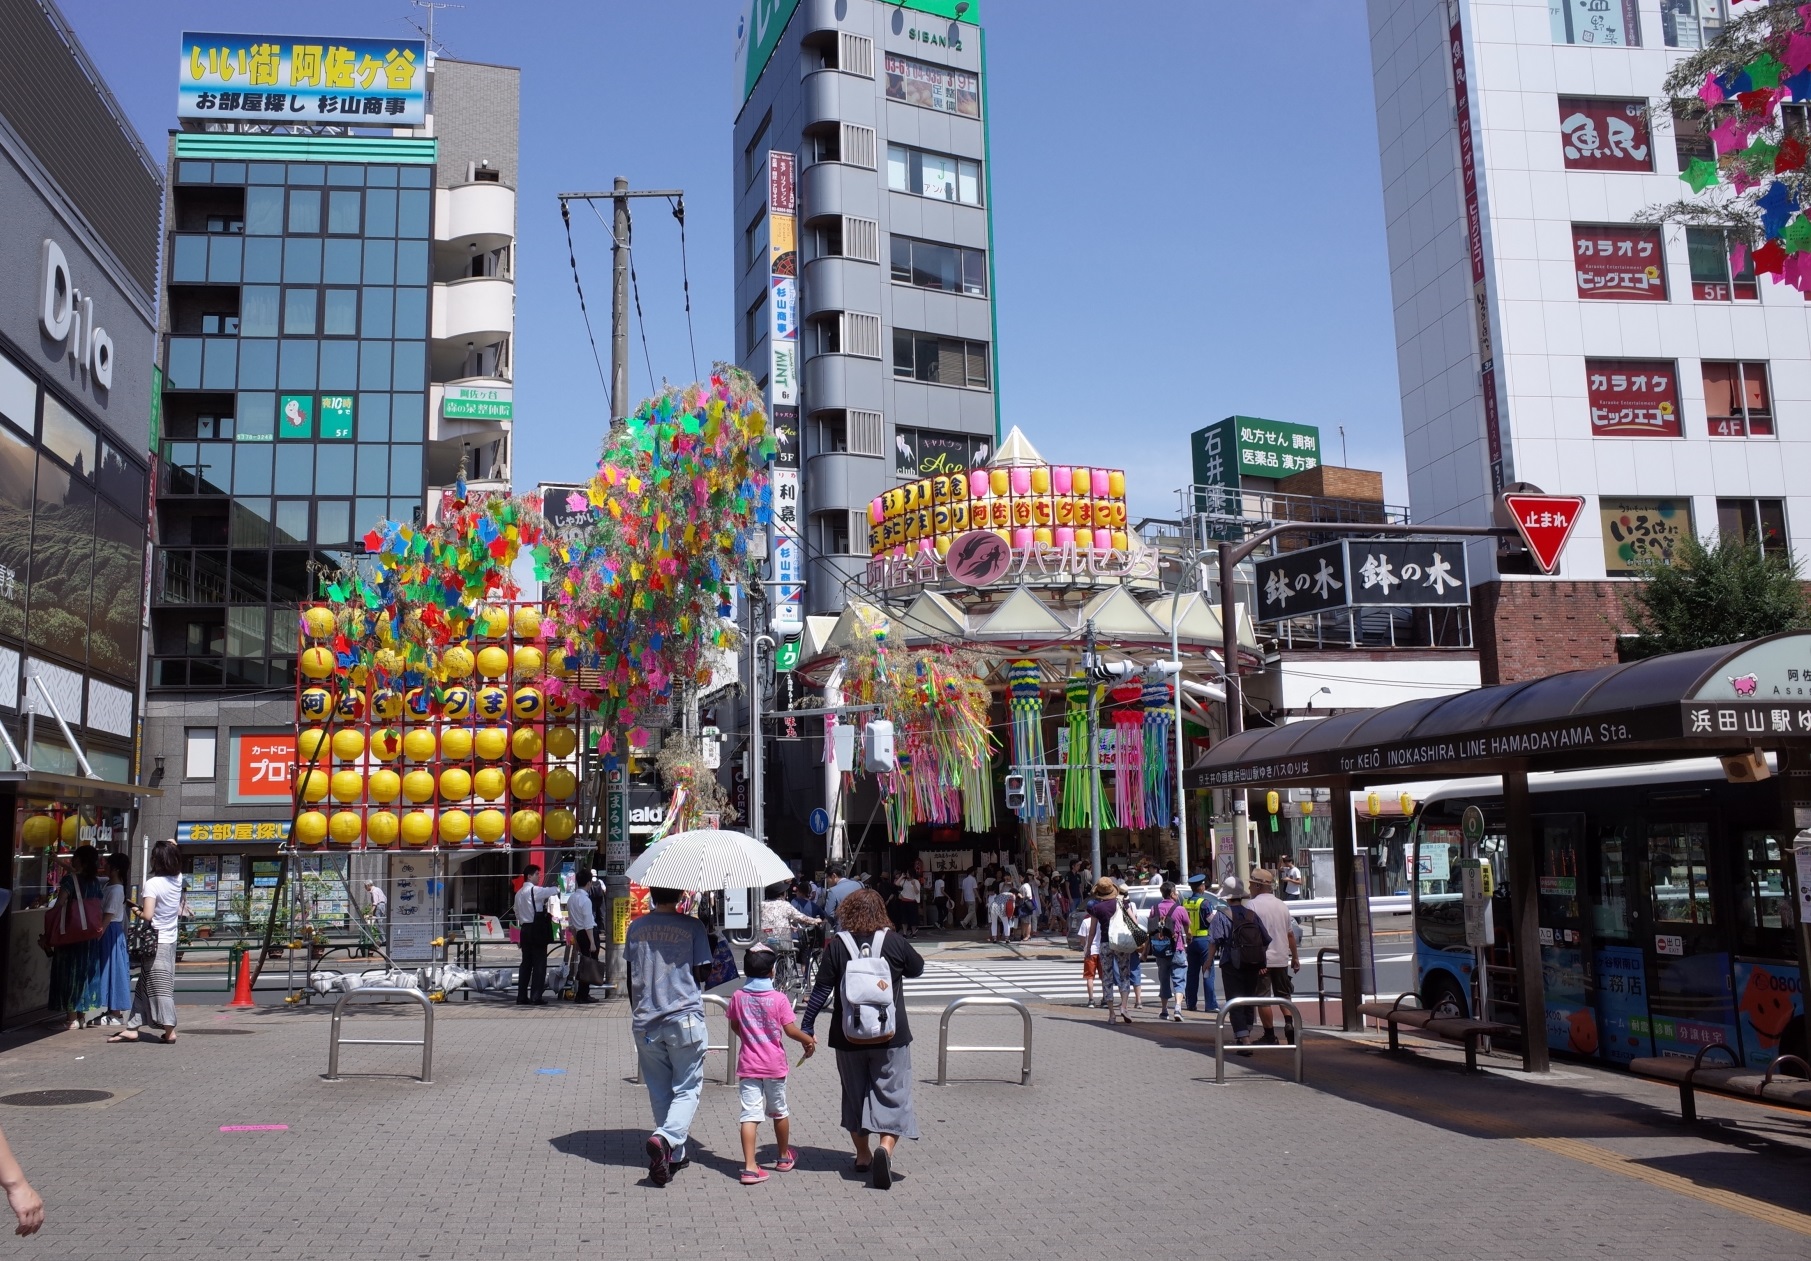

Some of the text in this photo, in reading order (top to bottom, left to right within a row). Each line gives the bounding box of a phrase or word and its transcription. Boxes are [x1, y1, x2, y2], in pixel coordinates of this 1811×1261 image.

[1549, 8, 1561, 16] 7F
[955, 40, 963, 51] 2
[190, 43, 280, 86] いい街
[195, 91, 407, 116] お部屋探し 杉山商事
[1561, 113, 1648, 161] 魚民
[1461, 119, 1475, 184] カラオケ
[1469, 200, 1483, 274] ビッグエコー
[1577, 240, 1653, 257] カラオケ
[1577, 270, 1661, 289] ビッグエコー
[1704, 284, 1726, 300] 5F
[39, 239, 114, 390] Dila
[775, 350, 788, 387] MINT
[1591, 374, 1667, 392] カラオケ
[1591, 407, 1675, 426] ビッグエコー
[336, 429, 348, 437] 5F
[1717, 421, 1741, 436] 4F
[1240, 426, 1316, 452] 処方せん 調剤
[780, 452, 795, 462] 5F
[1242, 449, 1317, 471] 医薬品 漢方薬
[972, 502, 1127, 523] 阿佐谷七夕まつり
[1524, 511, 1568, 528] 止まれ
[1263, 557, 1343, 608] 鉢の木
[1358, 552, 1463, 596] 鉢の木
[1773, 685, 1811, 697] Asa
[1340, 758, 1354, 770] for
[1387, 742, 1456, 766] INOKASHIRA
[1459, 738, 1487, 758] LINE
[1491, 727, 1594, 753] HAMADAYAMA
[1600, 723, 1632, 742] Sta.
[736, 784, 746, 823] OCEAN
[609, 794, 622, 839] まるや
[189, 821, 290, 841] お部屋探し
[936, 859, 958, 870] 味丸
[1666, 937, 1681, 947] 出口
